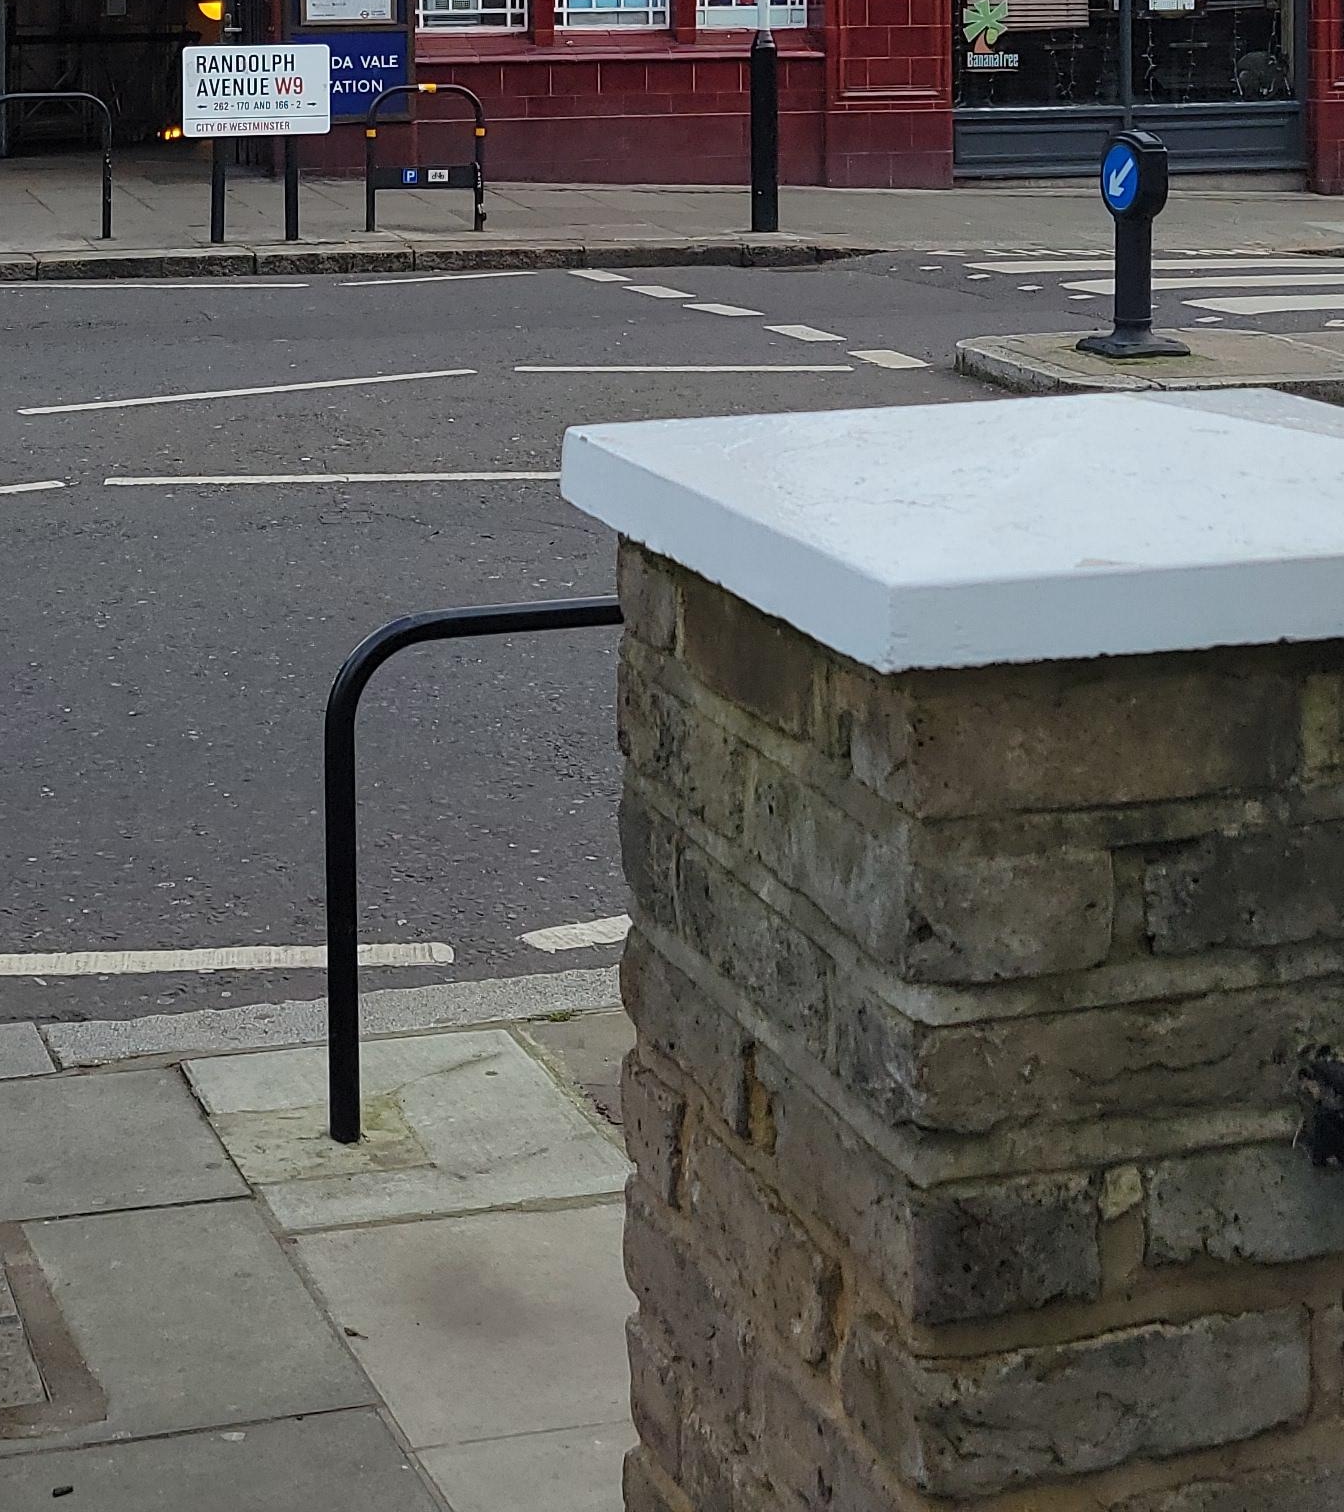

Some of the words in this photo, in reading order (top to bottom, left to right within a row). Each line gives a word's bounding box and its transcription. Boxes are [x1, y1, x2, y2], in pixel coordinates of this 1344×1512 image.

[196, 54, 296, 74] RANDOLPH
[360, 55, 399, 68] VALE
[967, 51, 1019, 67] BananaTree
[196, 77, 270, 97] AVENUE
[274, 76, 304, 95] W9
[253, 100, 271, 110] AND
[196, 123, 215, 132] CITY
[216, 122, 229, 132] OF
[229, 120, 291, 132] WESTMINSTER
